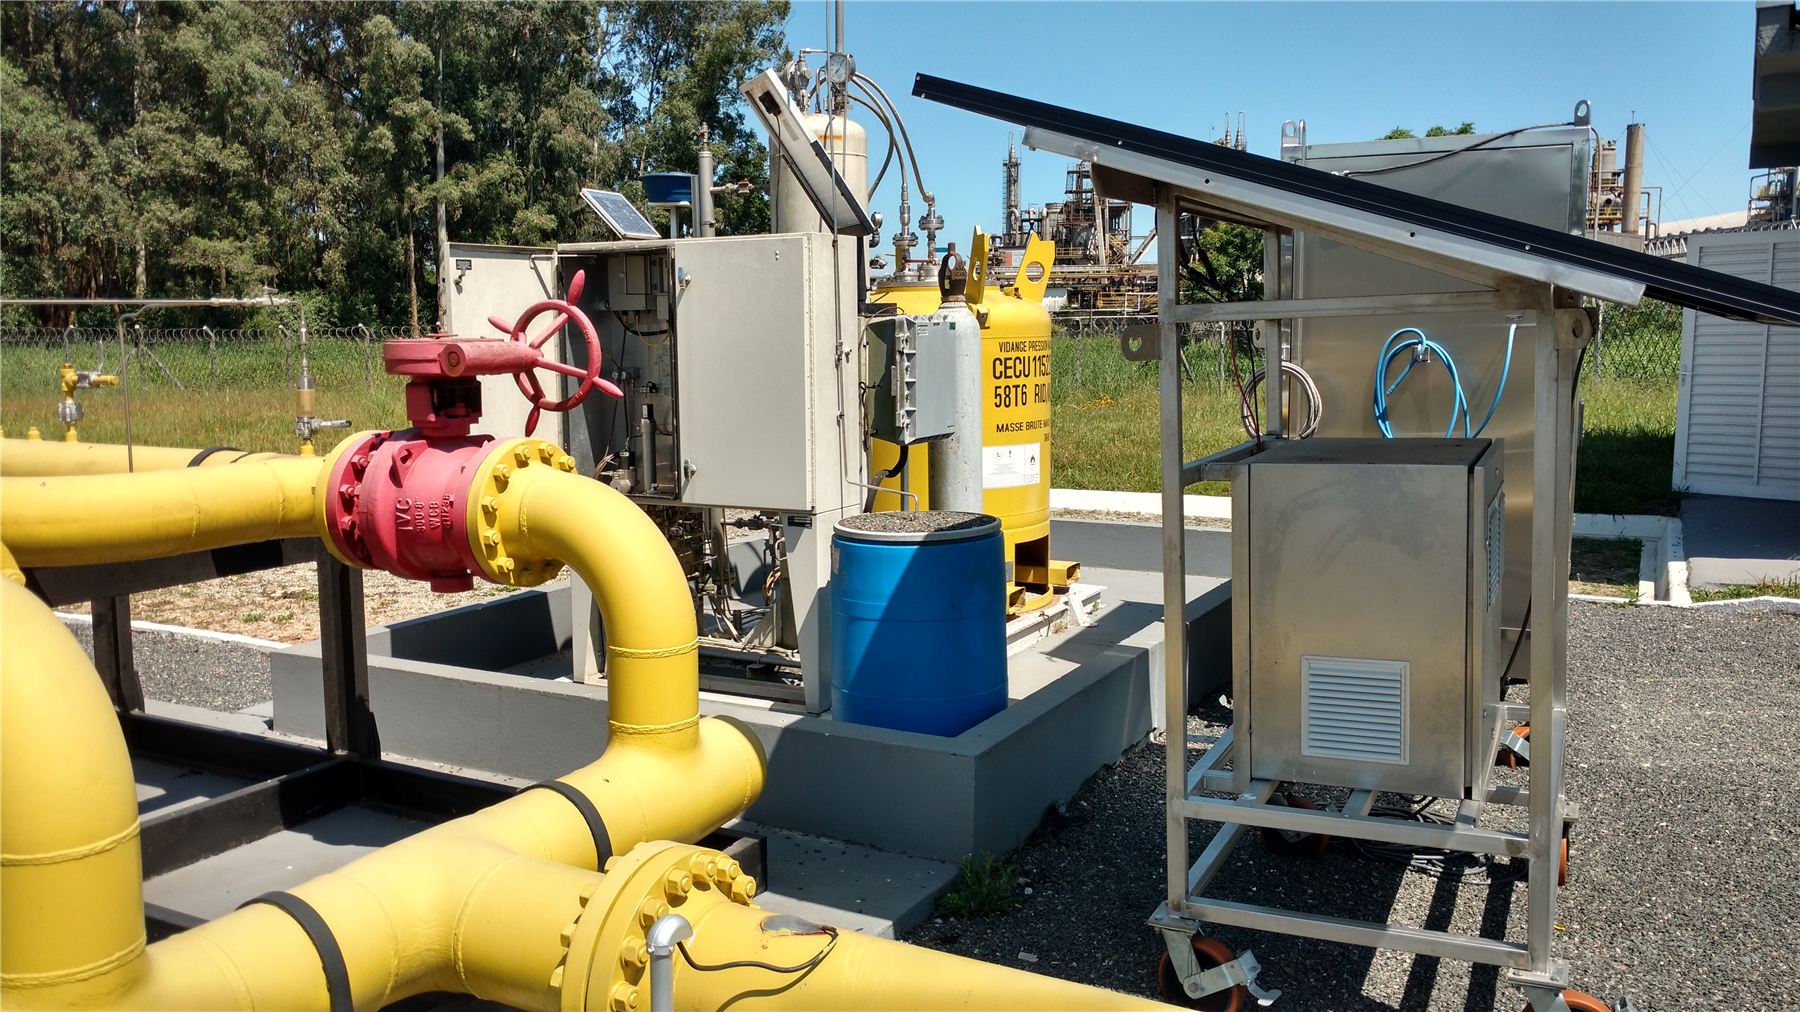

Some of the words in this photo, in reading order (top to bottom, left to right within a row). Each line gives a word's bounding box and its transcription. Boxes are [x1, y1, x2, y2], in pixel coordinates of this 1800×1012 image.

[999, 341, 1027, 353] VIDANGE
[994, 383, 1027, 408] 58T6
[996, 422, 1023, 432] MASSE
[1025, 419, 1043, 431] BRUTE
[395, 497, 413, 530] IVC
[429, 501, 440, 529] WCB
